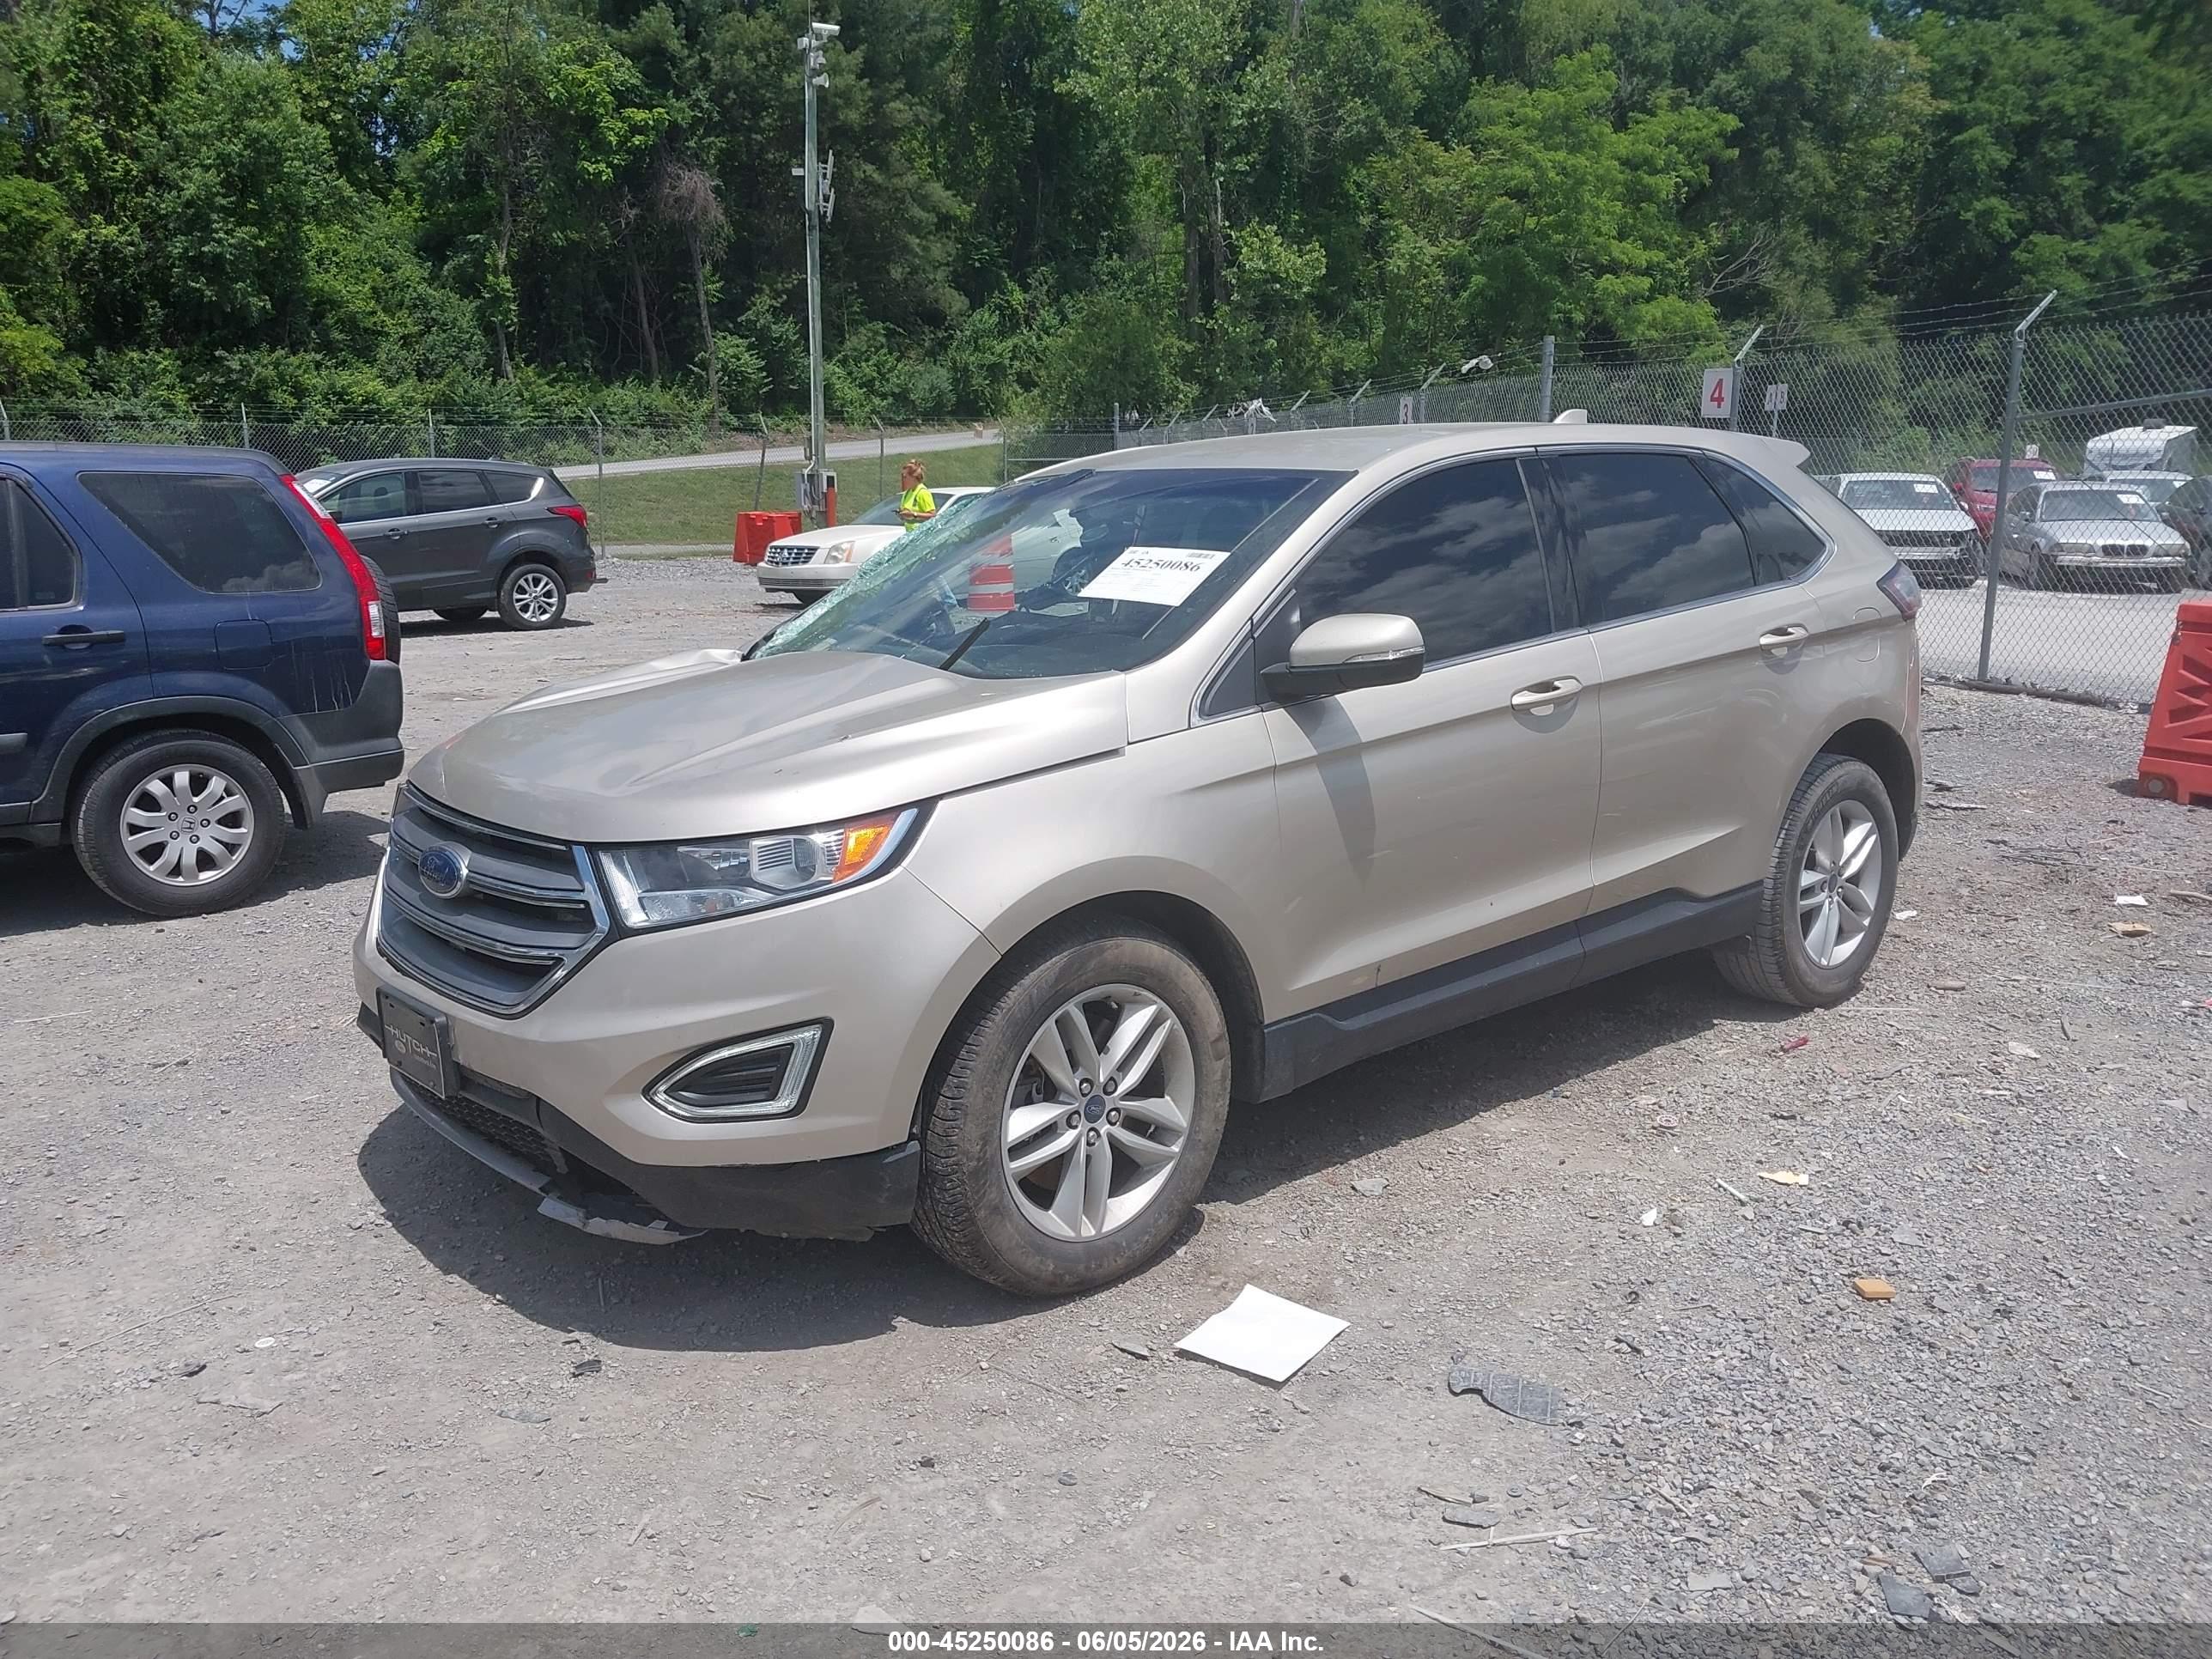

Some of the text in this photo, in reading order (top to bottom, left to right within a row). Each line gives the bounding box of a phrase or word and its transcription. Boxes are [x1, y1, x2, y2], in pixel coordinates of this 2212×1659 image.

[1710, 378, 1725, 409] 4
[1402, 403, 1408, 424] 3
[1121, 557, 1204, 572] 45250086
[385, 1024, 437, 1057] HUTCH
